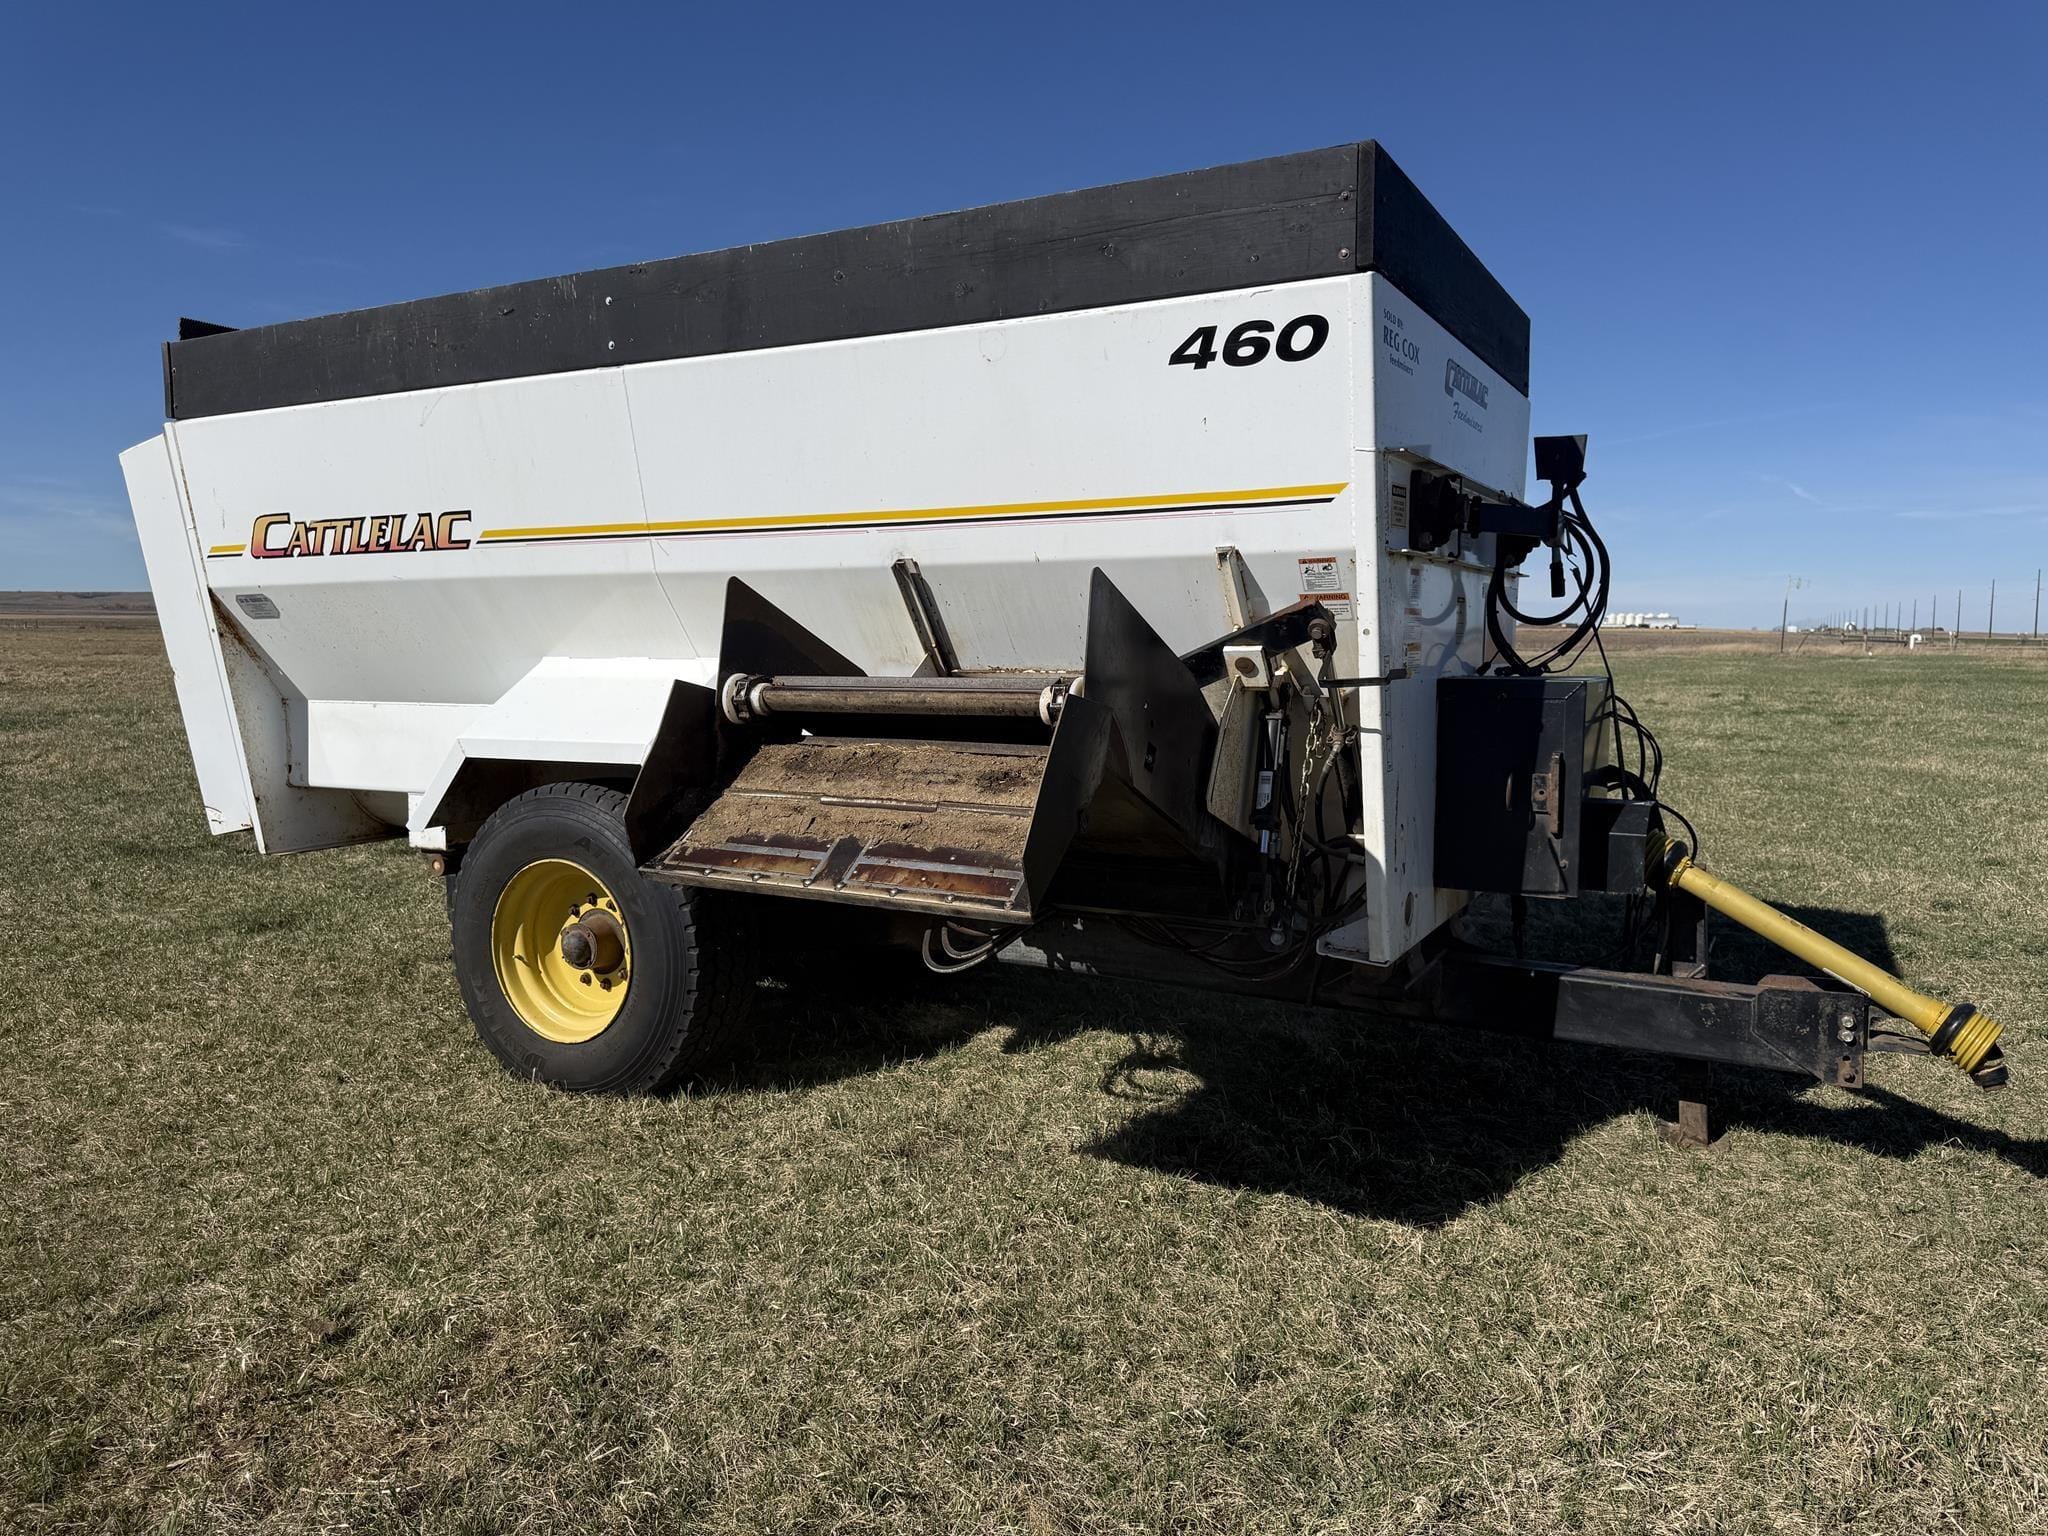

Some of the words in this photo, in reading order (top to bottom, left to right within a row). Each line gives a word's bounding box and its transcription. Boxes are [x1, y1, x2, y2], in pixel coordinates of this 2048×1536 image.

[1383, 308, 1397, 325] SOLD
[1168, 314, 1330, 370] 460
[1383, 324, 1400, 353] REG
[1402, 338, 1420, 365] COX
